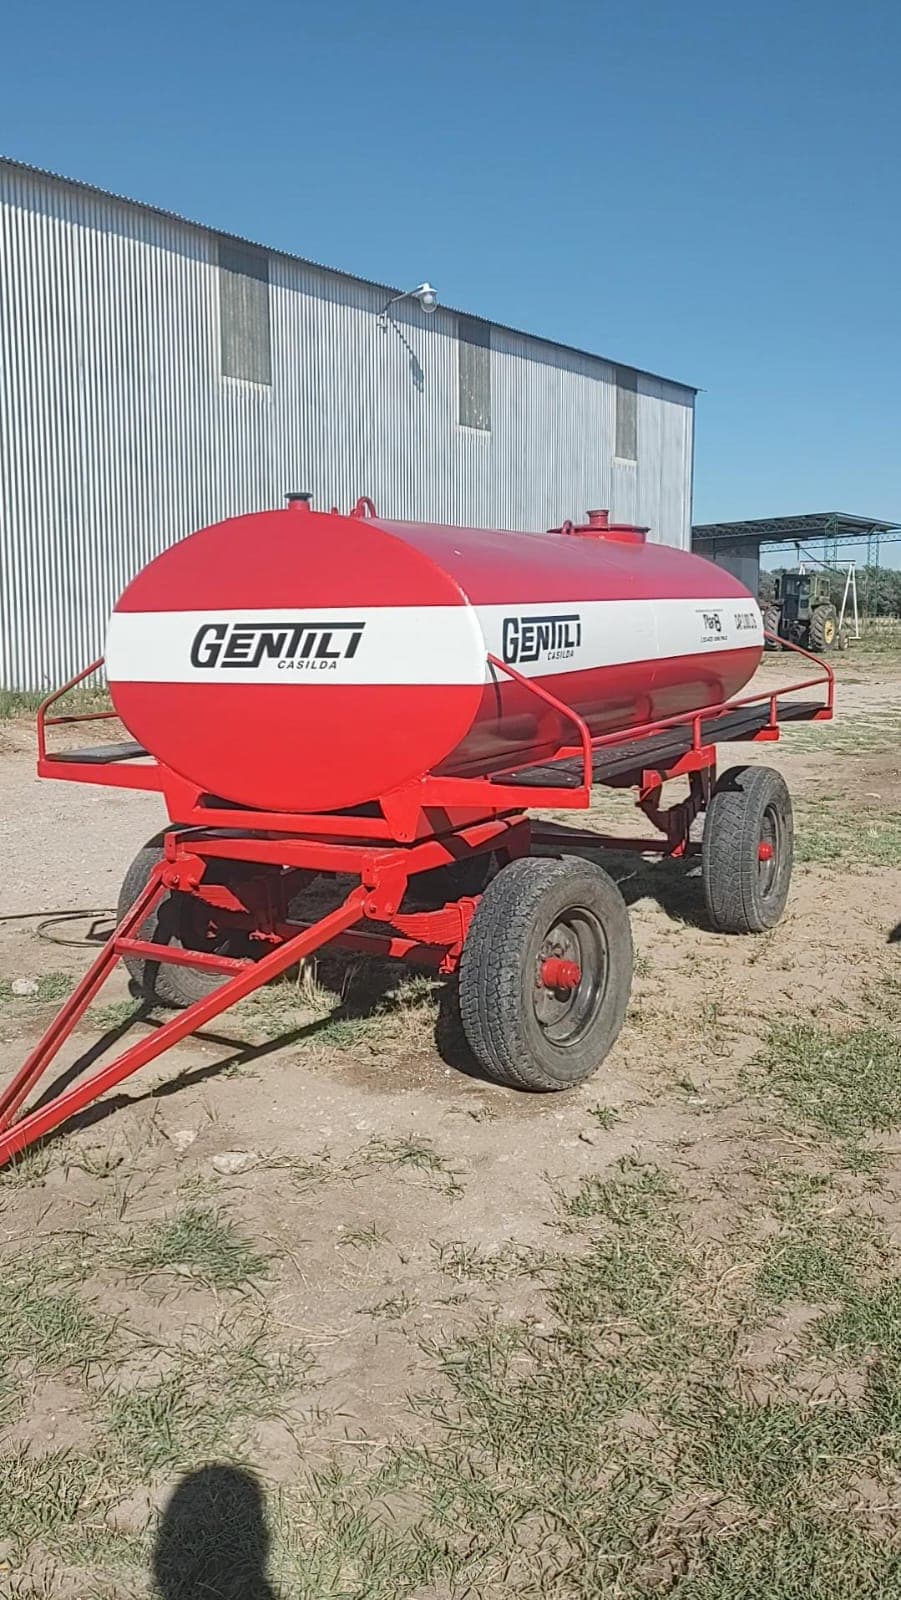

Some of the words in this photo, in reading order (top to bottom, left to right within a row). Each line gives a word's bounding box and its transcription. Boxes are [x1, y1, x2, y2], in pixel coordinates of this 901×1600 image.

[190, 621, 366, 668] GENTILI
[502, 614, 581, 664] GENTILI
[277, 660, 337, 670] CASILDA
[547, 650, 574, 661] CASILDA
